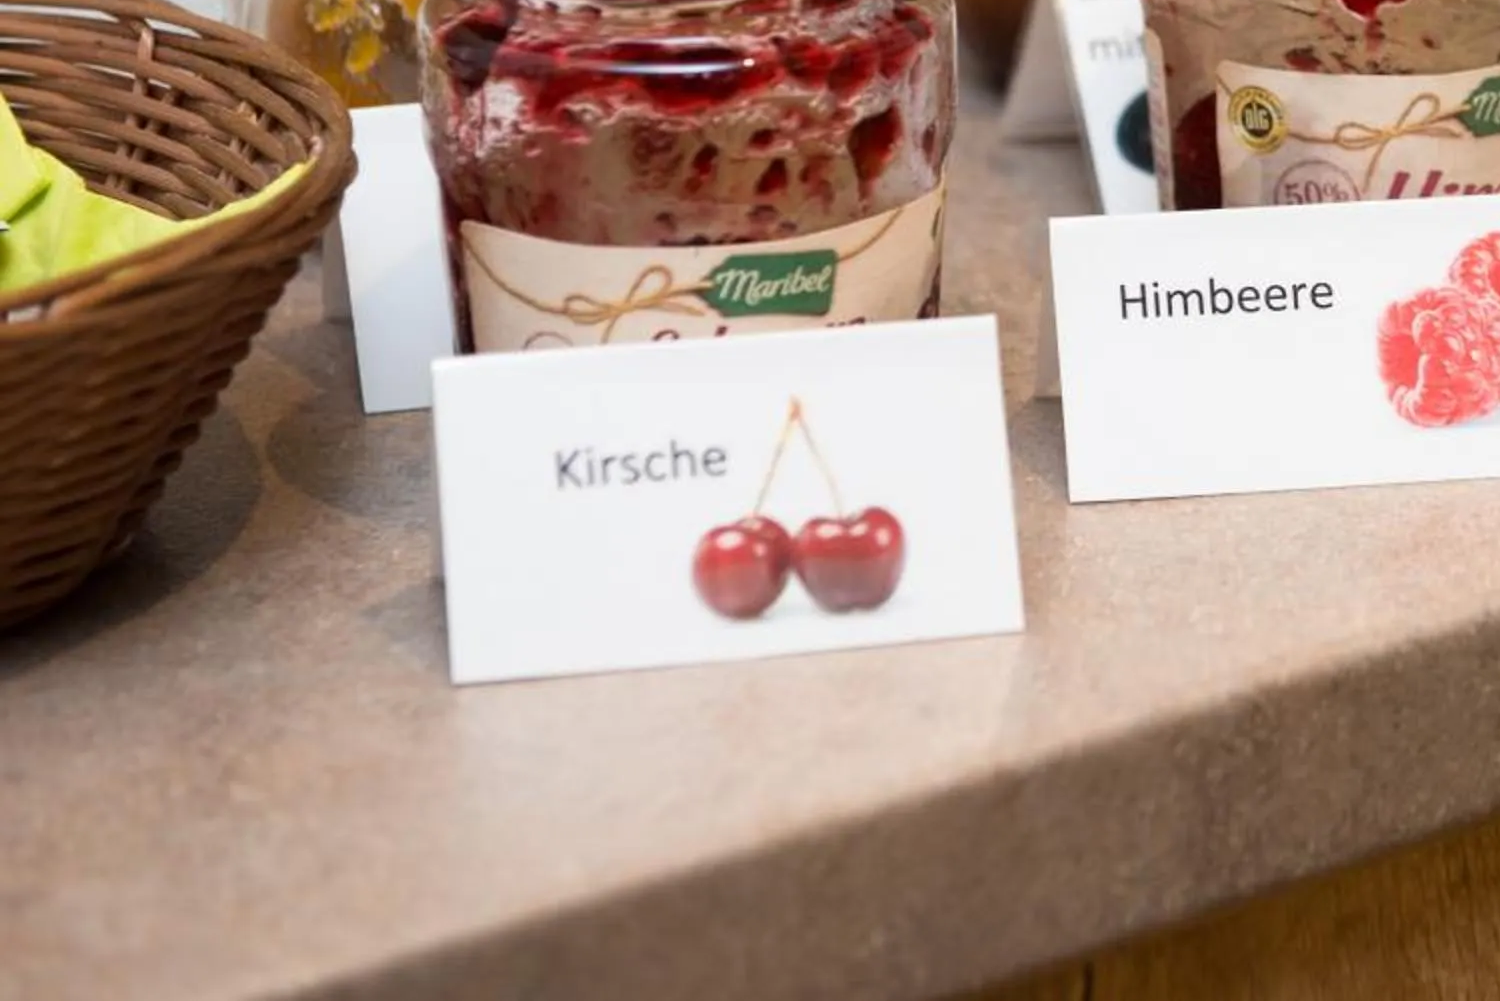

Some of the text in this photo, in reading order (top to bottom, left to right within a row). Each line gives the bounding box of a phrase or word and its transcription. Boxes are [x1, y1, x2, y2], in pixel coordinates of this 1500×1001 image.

[715, 265, 832, 307] Maribel
[1118, 277, 1335, 320] Himbeere
[554, 440, 729, 490] Kirsche
